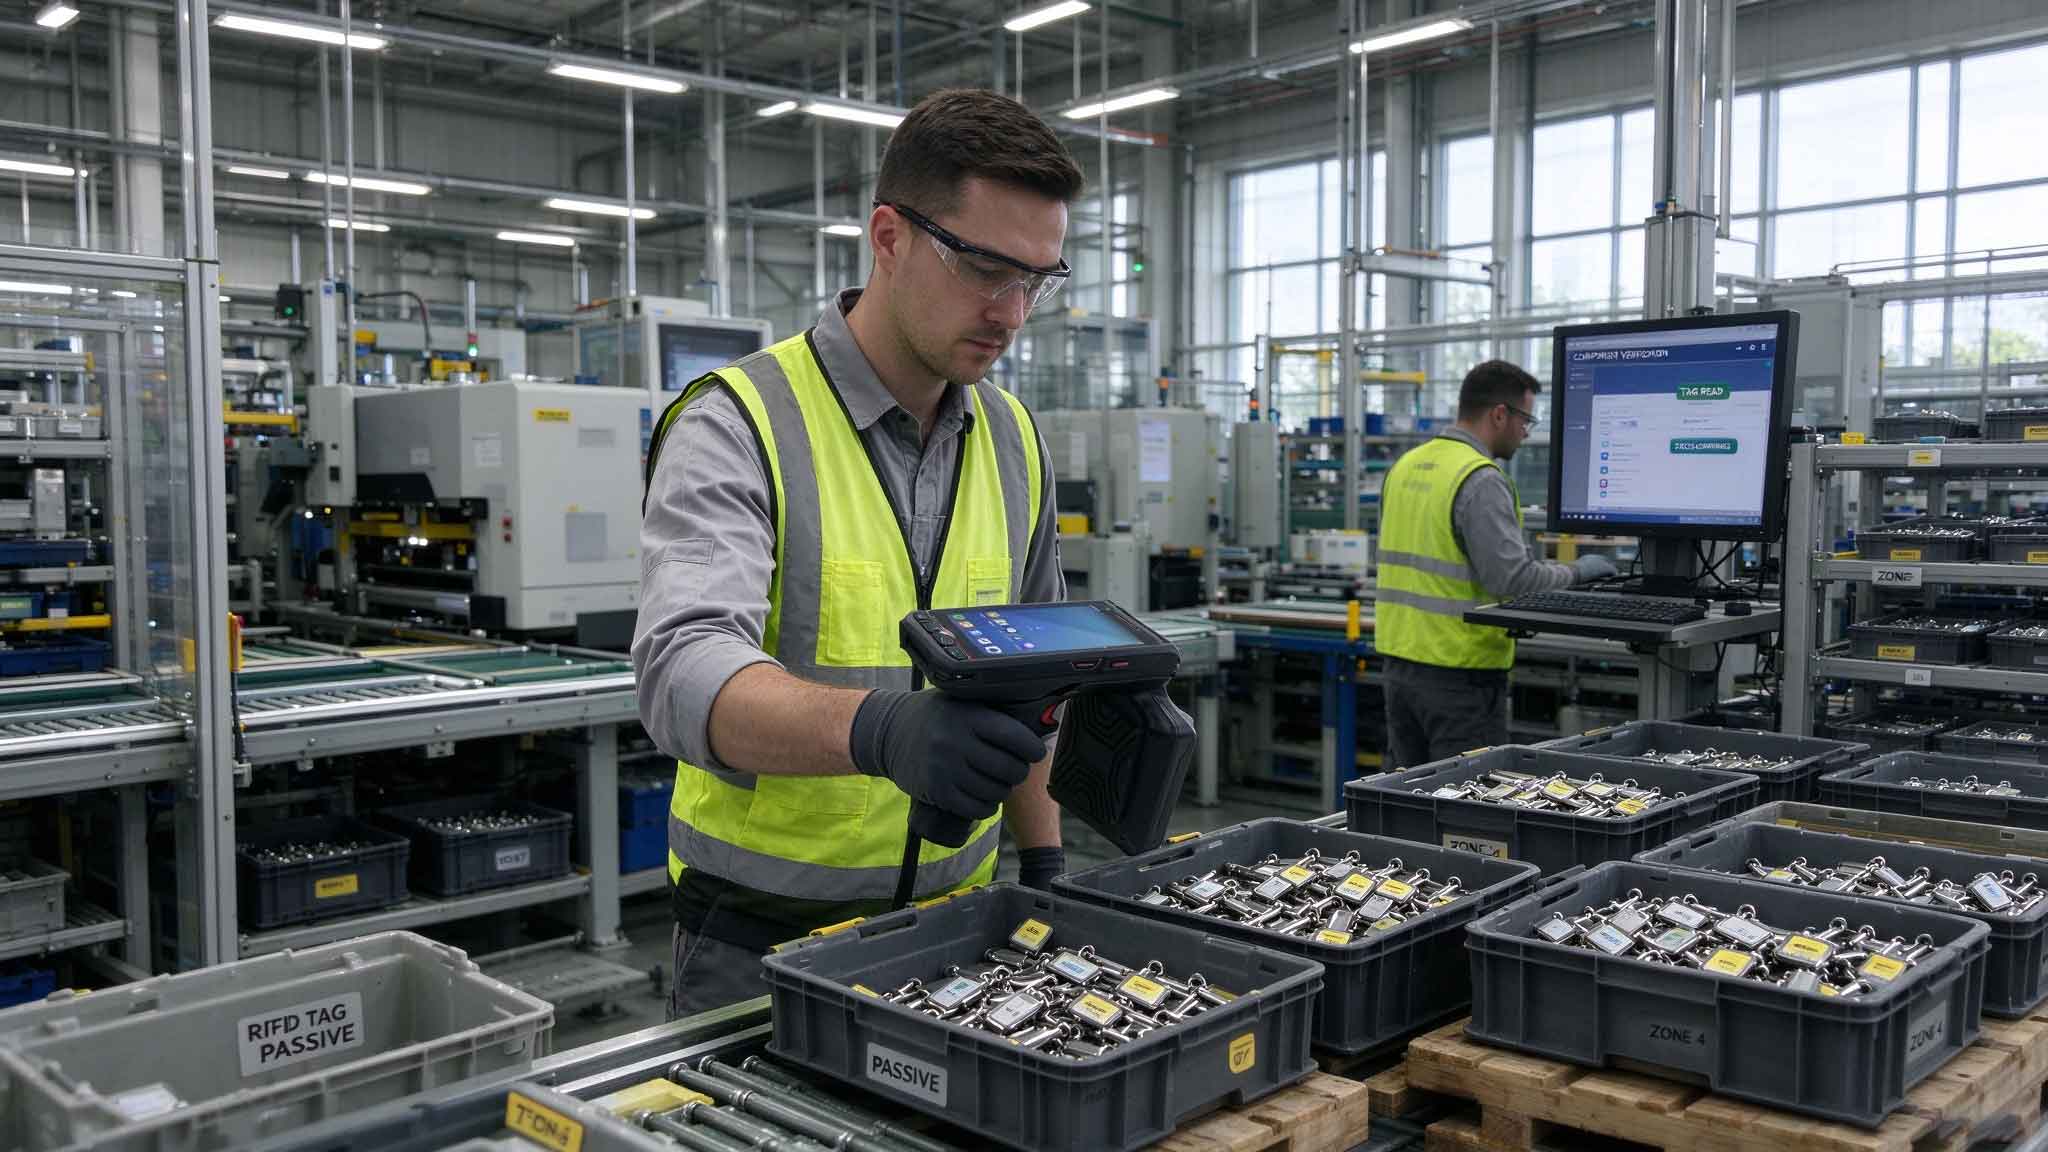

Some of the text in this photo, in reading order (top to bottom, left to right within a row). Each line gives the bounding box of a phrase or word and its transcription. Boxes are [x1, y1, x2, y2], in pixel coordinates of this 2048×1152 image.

[1680, 386, 1724, 397] TAG READ
[305, 1003, 346, 1027] TAG
[260, 1023, 355, 1064] PASSIVE
[1649, 1023, 1705, 1047] ZONE 4
[872, 1055, 940, 1093] PASSIVE
